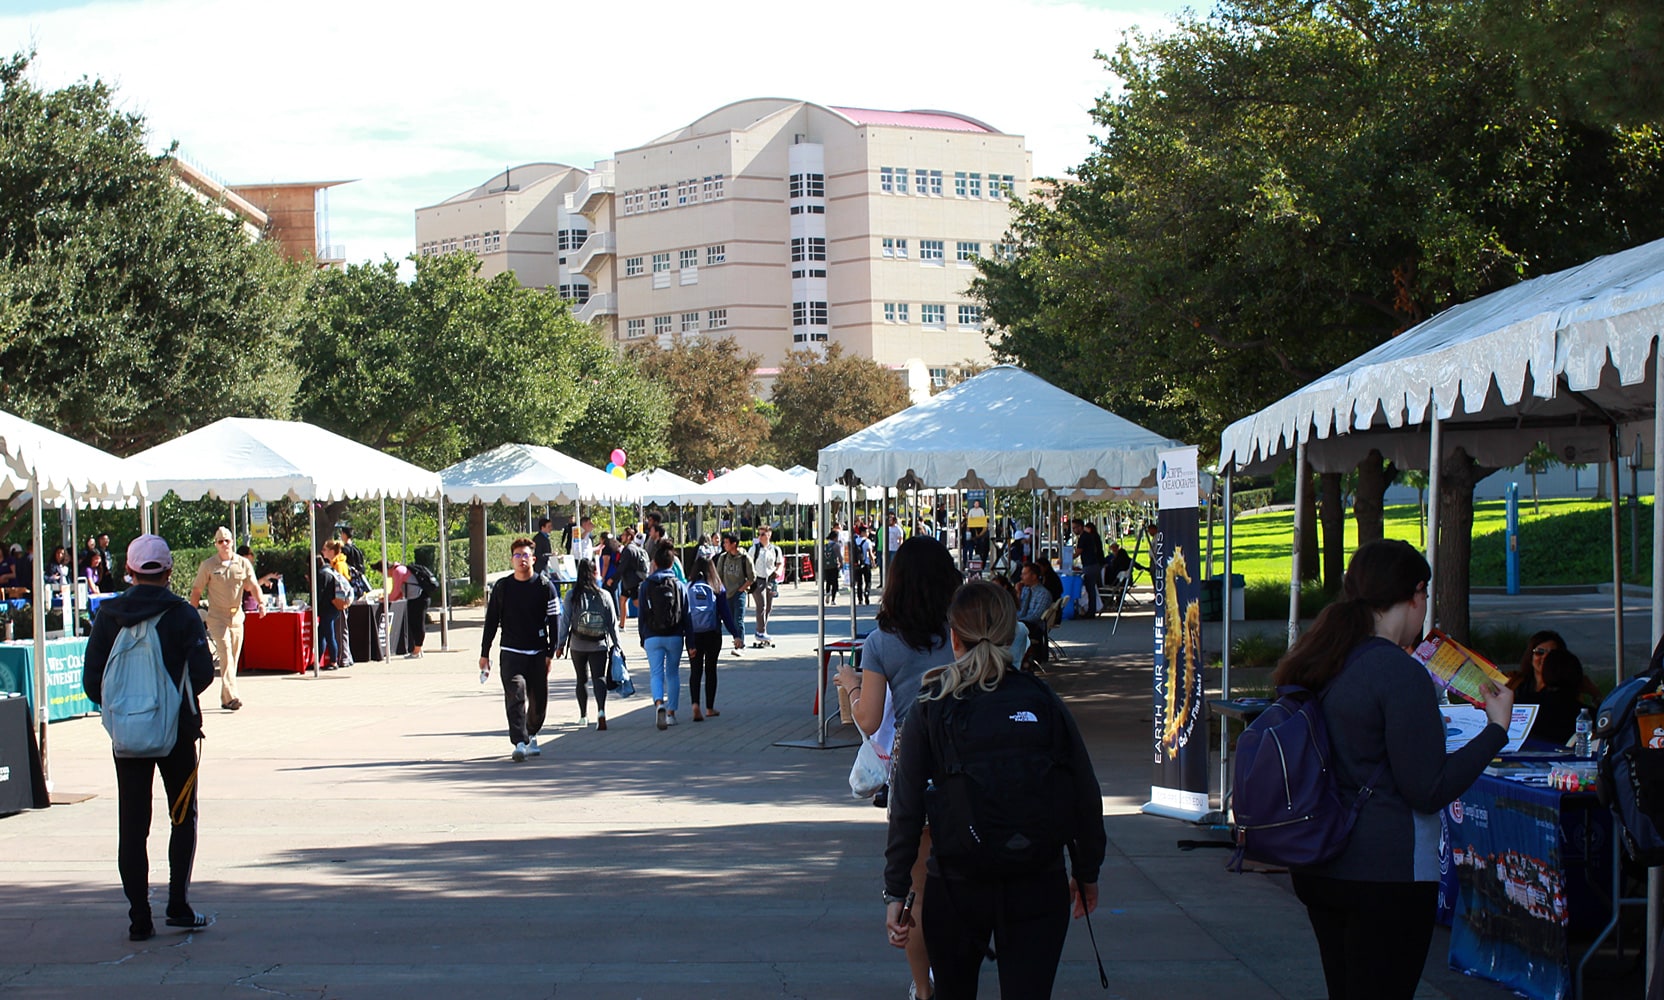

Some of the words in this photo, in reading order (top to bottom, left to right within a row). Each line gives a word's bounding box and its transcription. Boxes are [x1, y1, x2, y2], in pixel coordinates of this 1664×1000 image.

[1155, 531, 1164, 606] OCEANS
[1155, 616, 1164, 655] LIFE
[1155, 664, 1163, 695] AIR
[1154, 705, 1163, 764] EARTH
